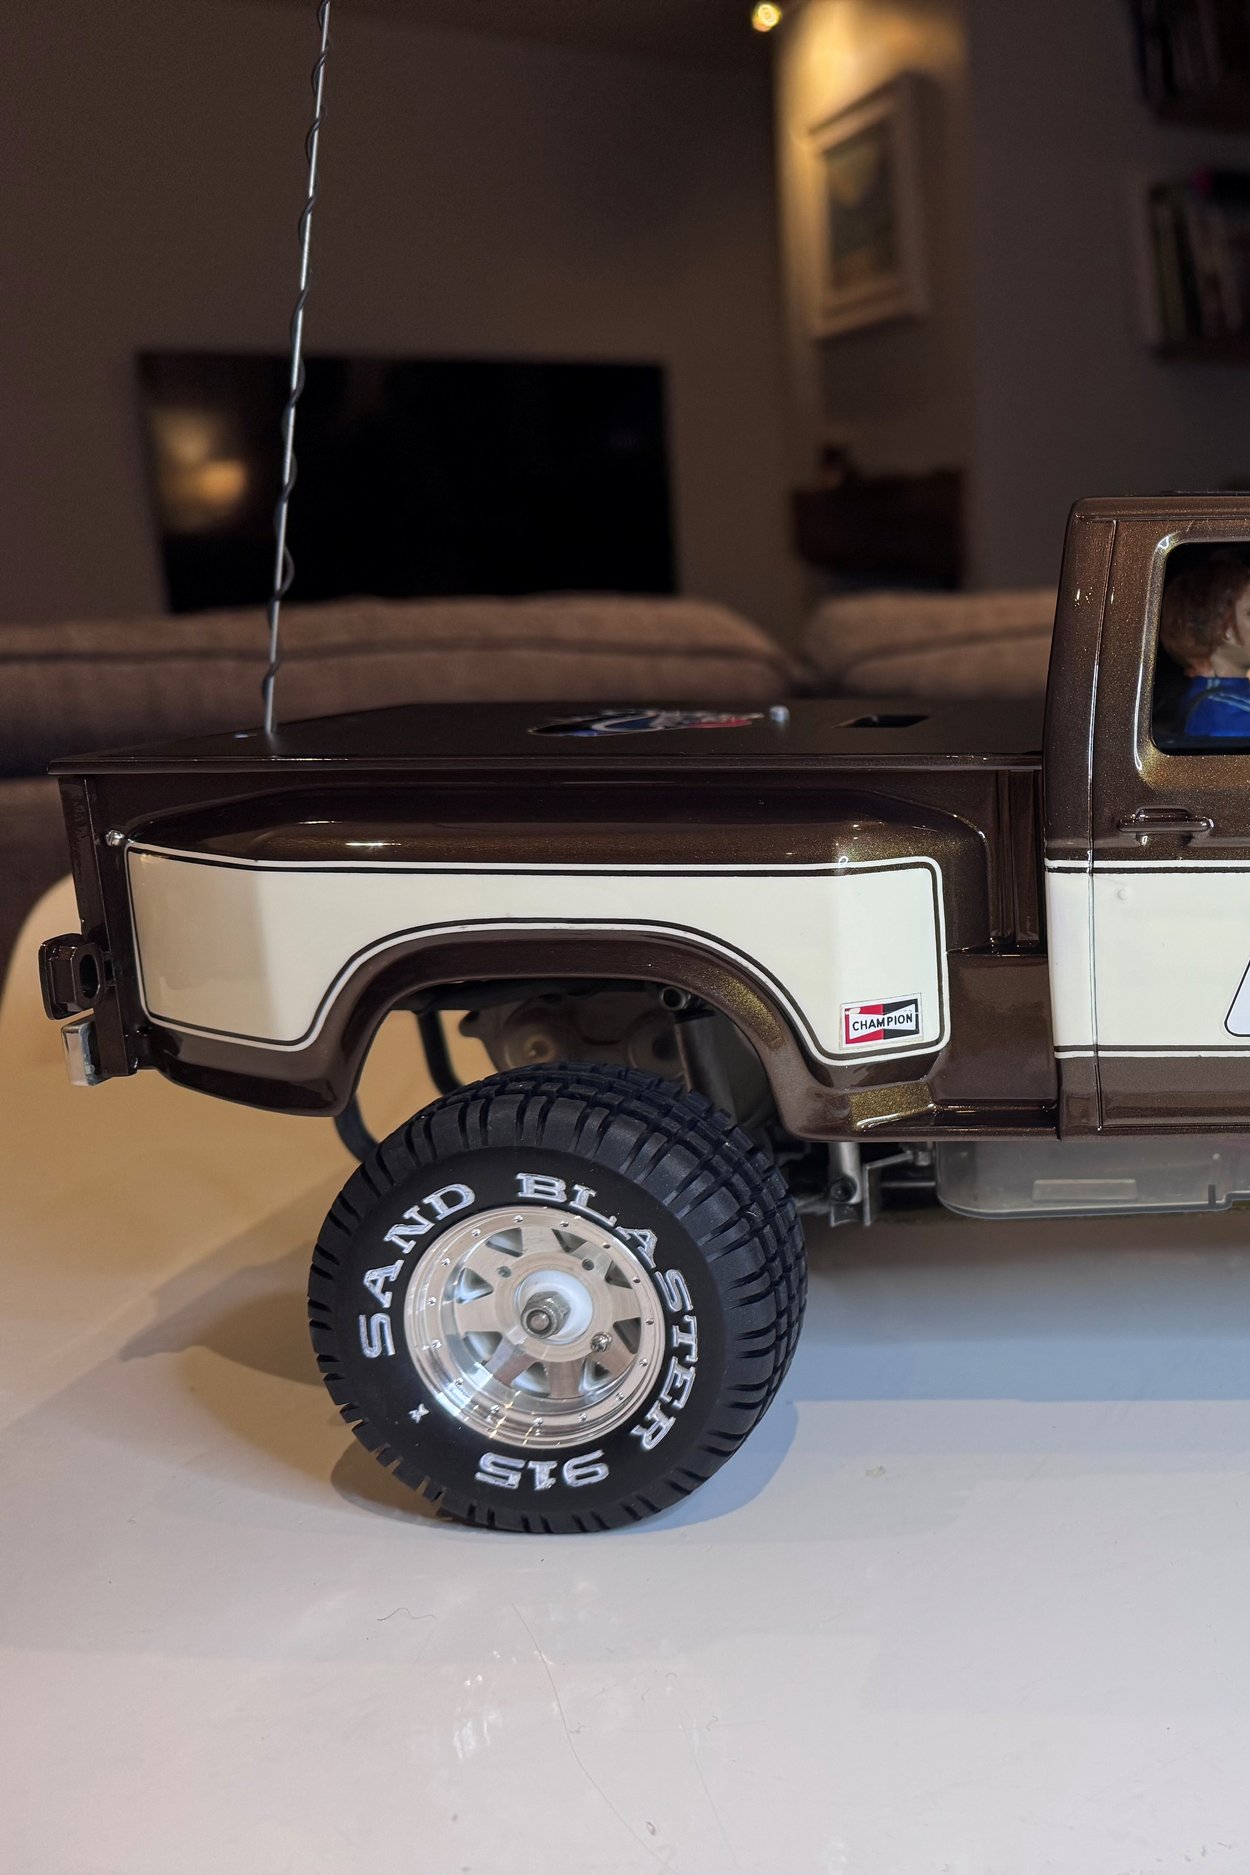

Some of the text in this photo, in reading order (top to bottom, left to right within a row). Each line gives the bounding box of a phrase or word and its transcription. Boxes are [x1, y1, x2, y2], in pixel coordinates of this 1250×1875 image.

[852, 1013, 913, 1031] CHAMPION
[358, 1172, 699, 1451] SAND BLASTER
[475, 1449, 610, 1491] 915
